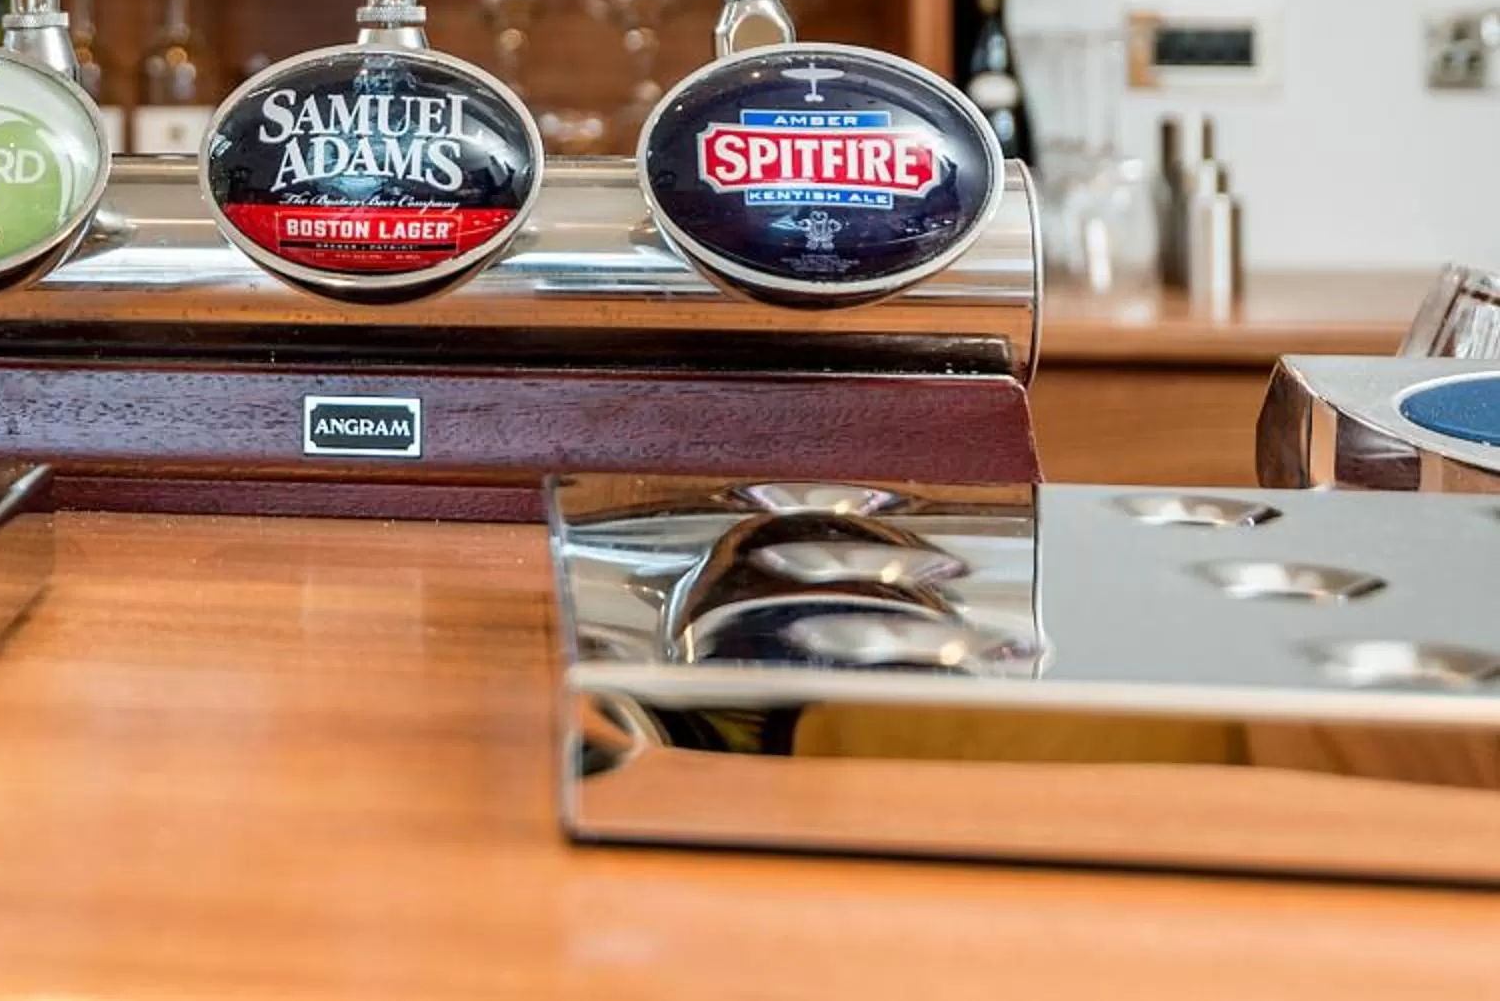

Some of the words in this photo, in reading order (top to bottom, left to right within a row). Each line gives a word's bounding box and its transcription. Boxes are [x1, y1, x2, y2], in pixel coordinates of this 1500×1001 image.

[259, 88, 483, 145] SAMUEL
[773, 115, 859, 126] AMBER
[270, 136, 463, 192] ADAMS
[714, 135, 920, 185] SPITFIRE
[750, 190, 840, 201] KENTISH
[848, 193, 889, 204] ALE
[286, 218, 370, 239] BOSTON
[379, 220, 450, 240] LAGER
[314, 418, 411, 436] ANGRAM
